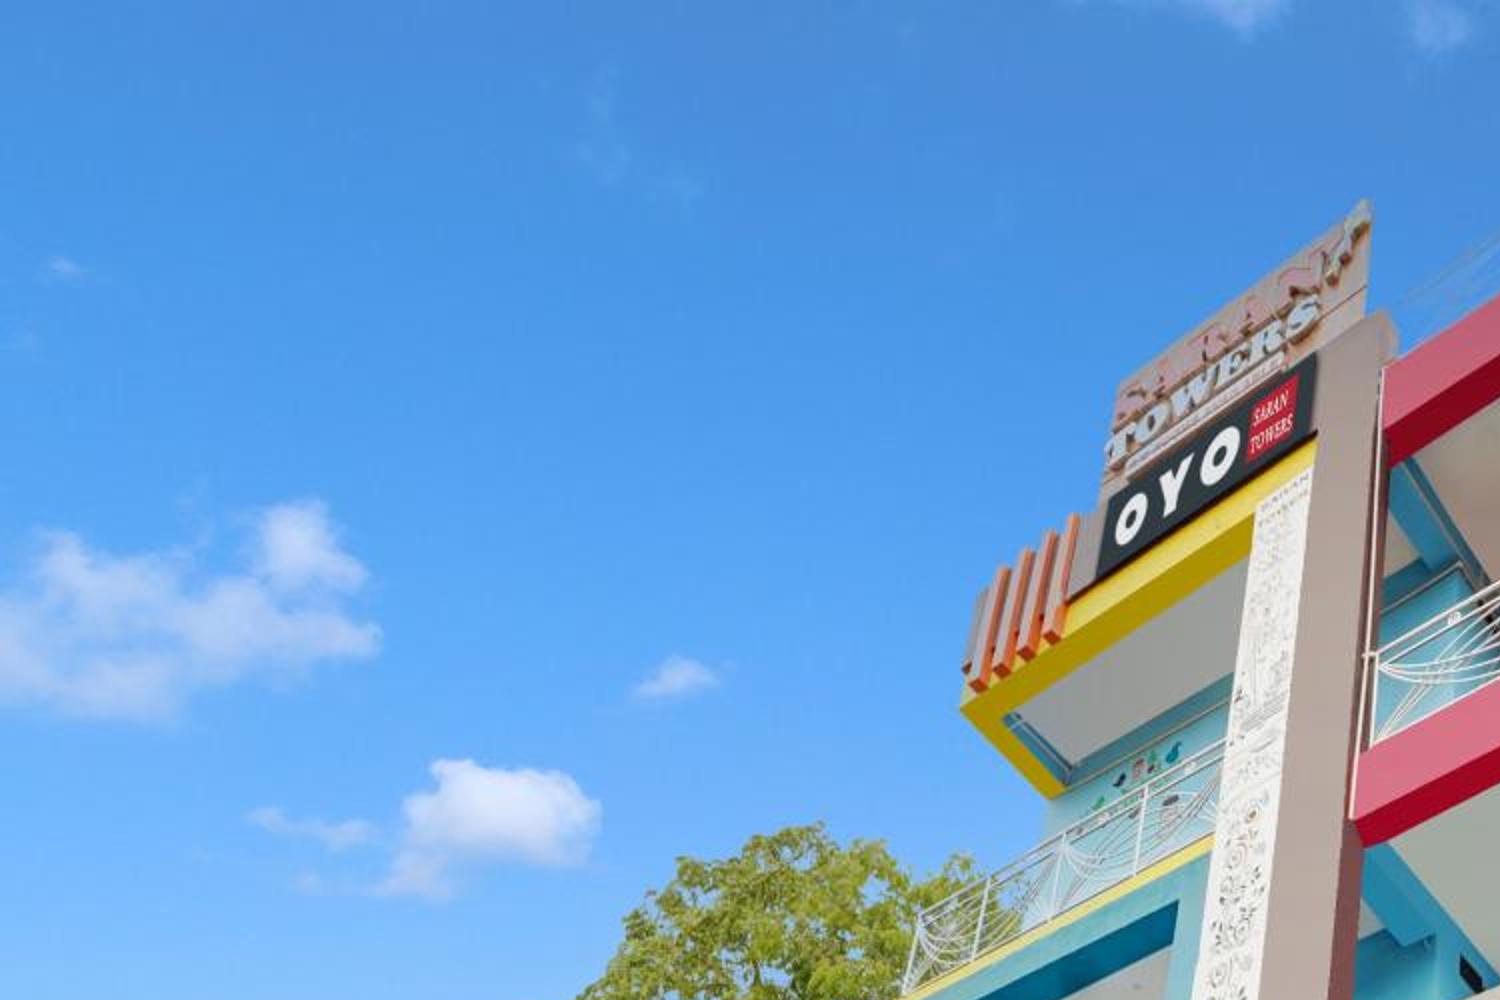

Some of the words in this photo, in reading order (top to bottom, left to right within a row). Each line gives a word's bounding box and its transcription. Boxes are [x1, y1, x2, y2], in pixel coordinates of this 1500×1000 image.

[1103, 294, 1321, 466] TOWERS
[1252, 387, 1290, 428] SARAN
[1249, 412, 1294, 455] TOWERS
[1115, 425, 1241, 546] OYO
